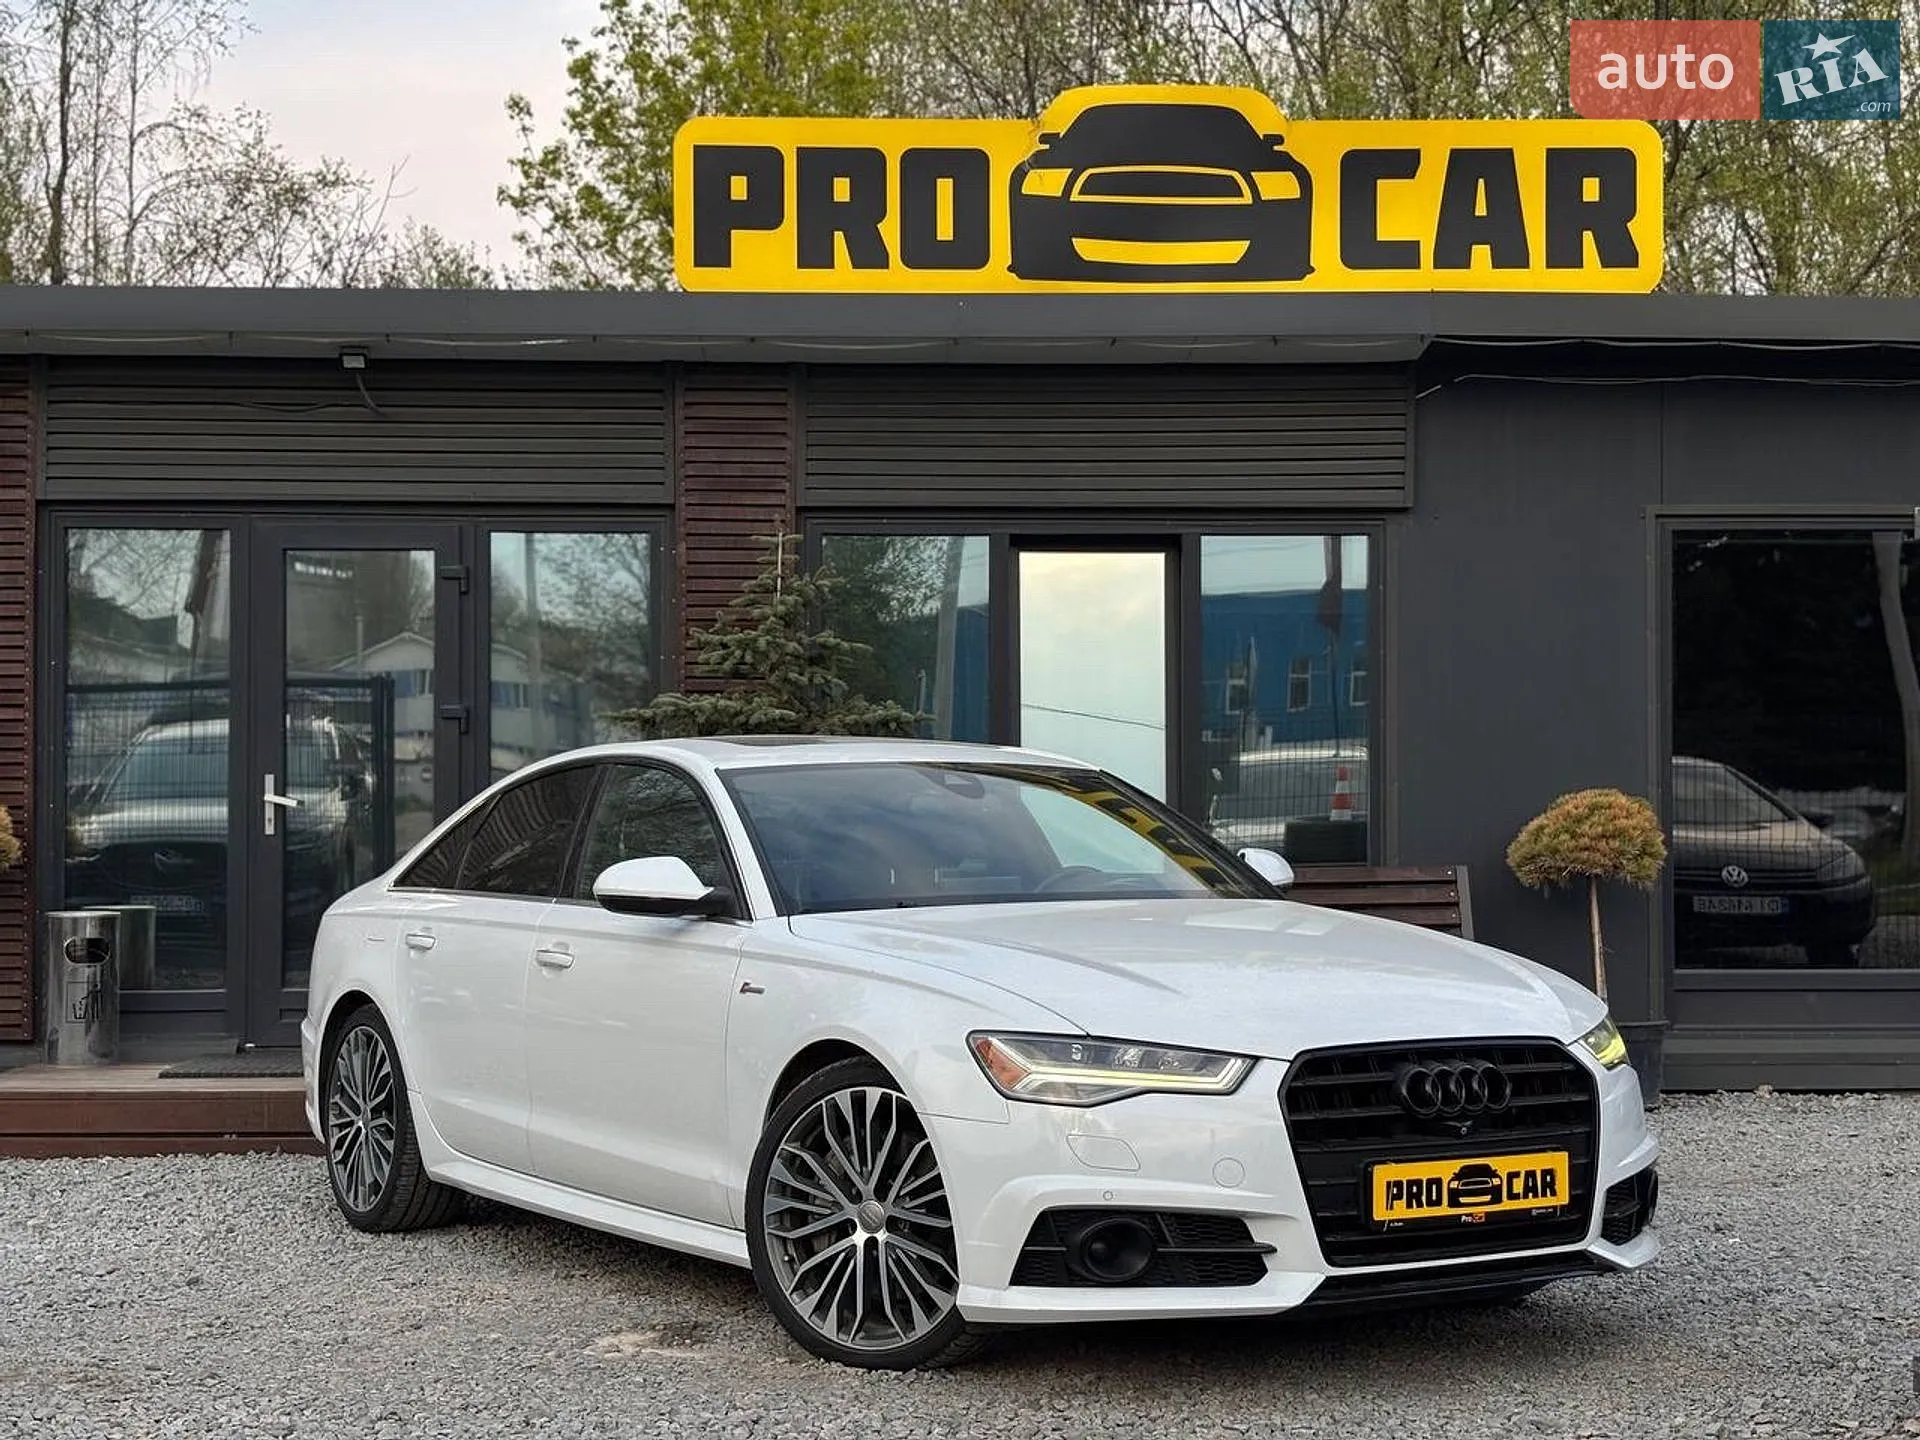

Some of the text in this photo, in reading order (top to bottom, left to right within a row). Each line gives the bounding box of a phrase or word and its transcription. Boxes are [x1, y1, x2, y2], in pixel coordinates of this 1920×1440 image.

[693, 145, 1639, 270] PRO CAR
[1385, 1168, 1557, 1211] PRO CAR
